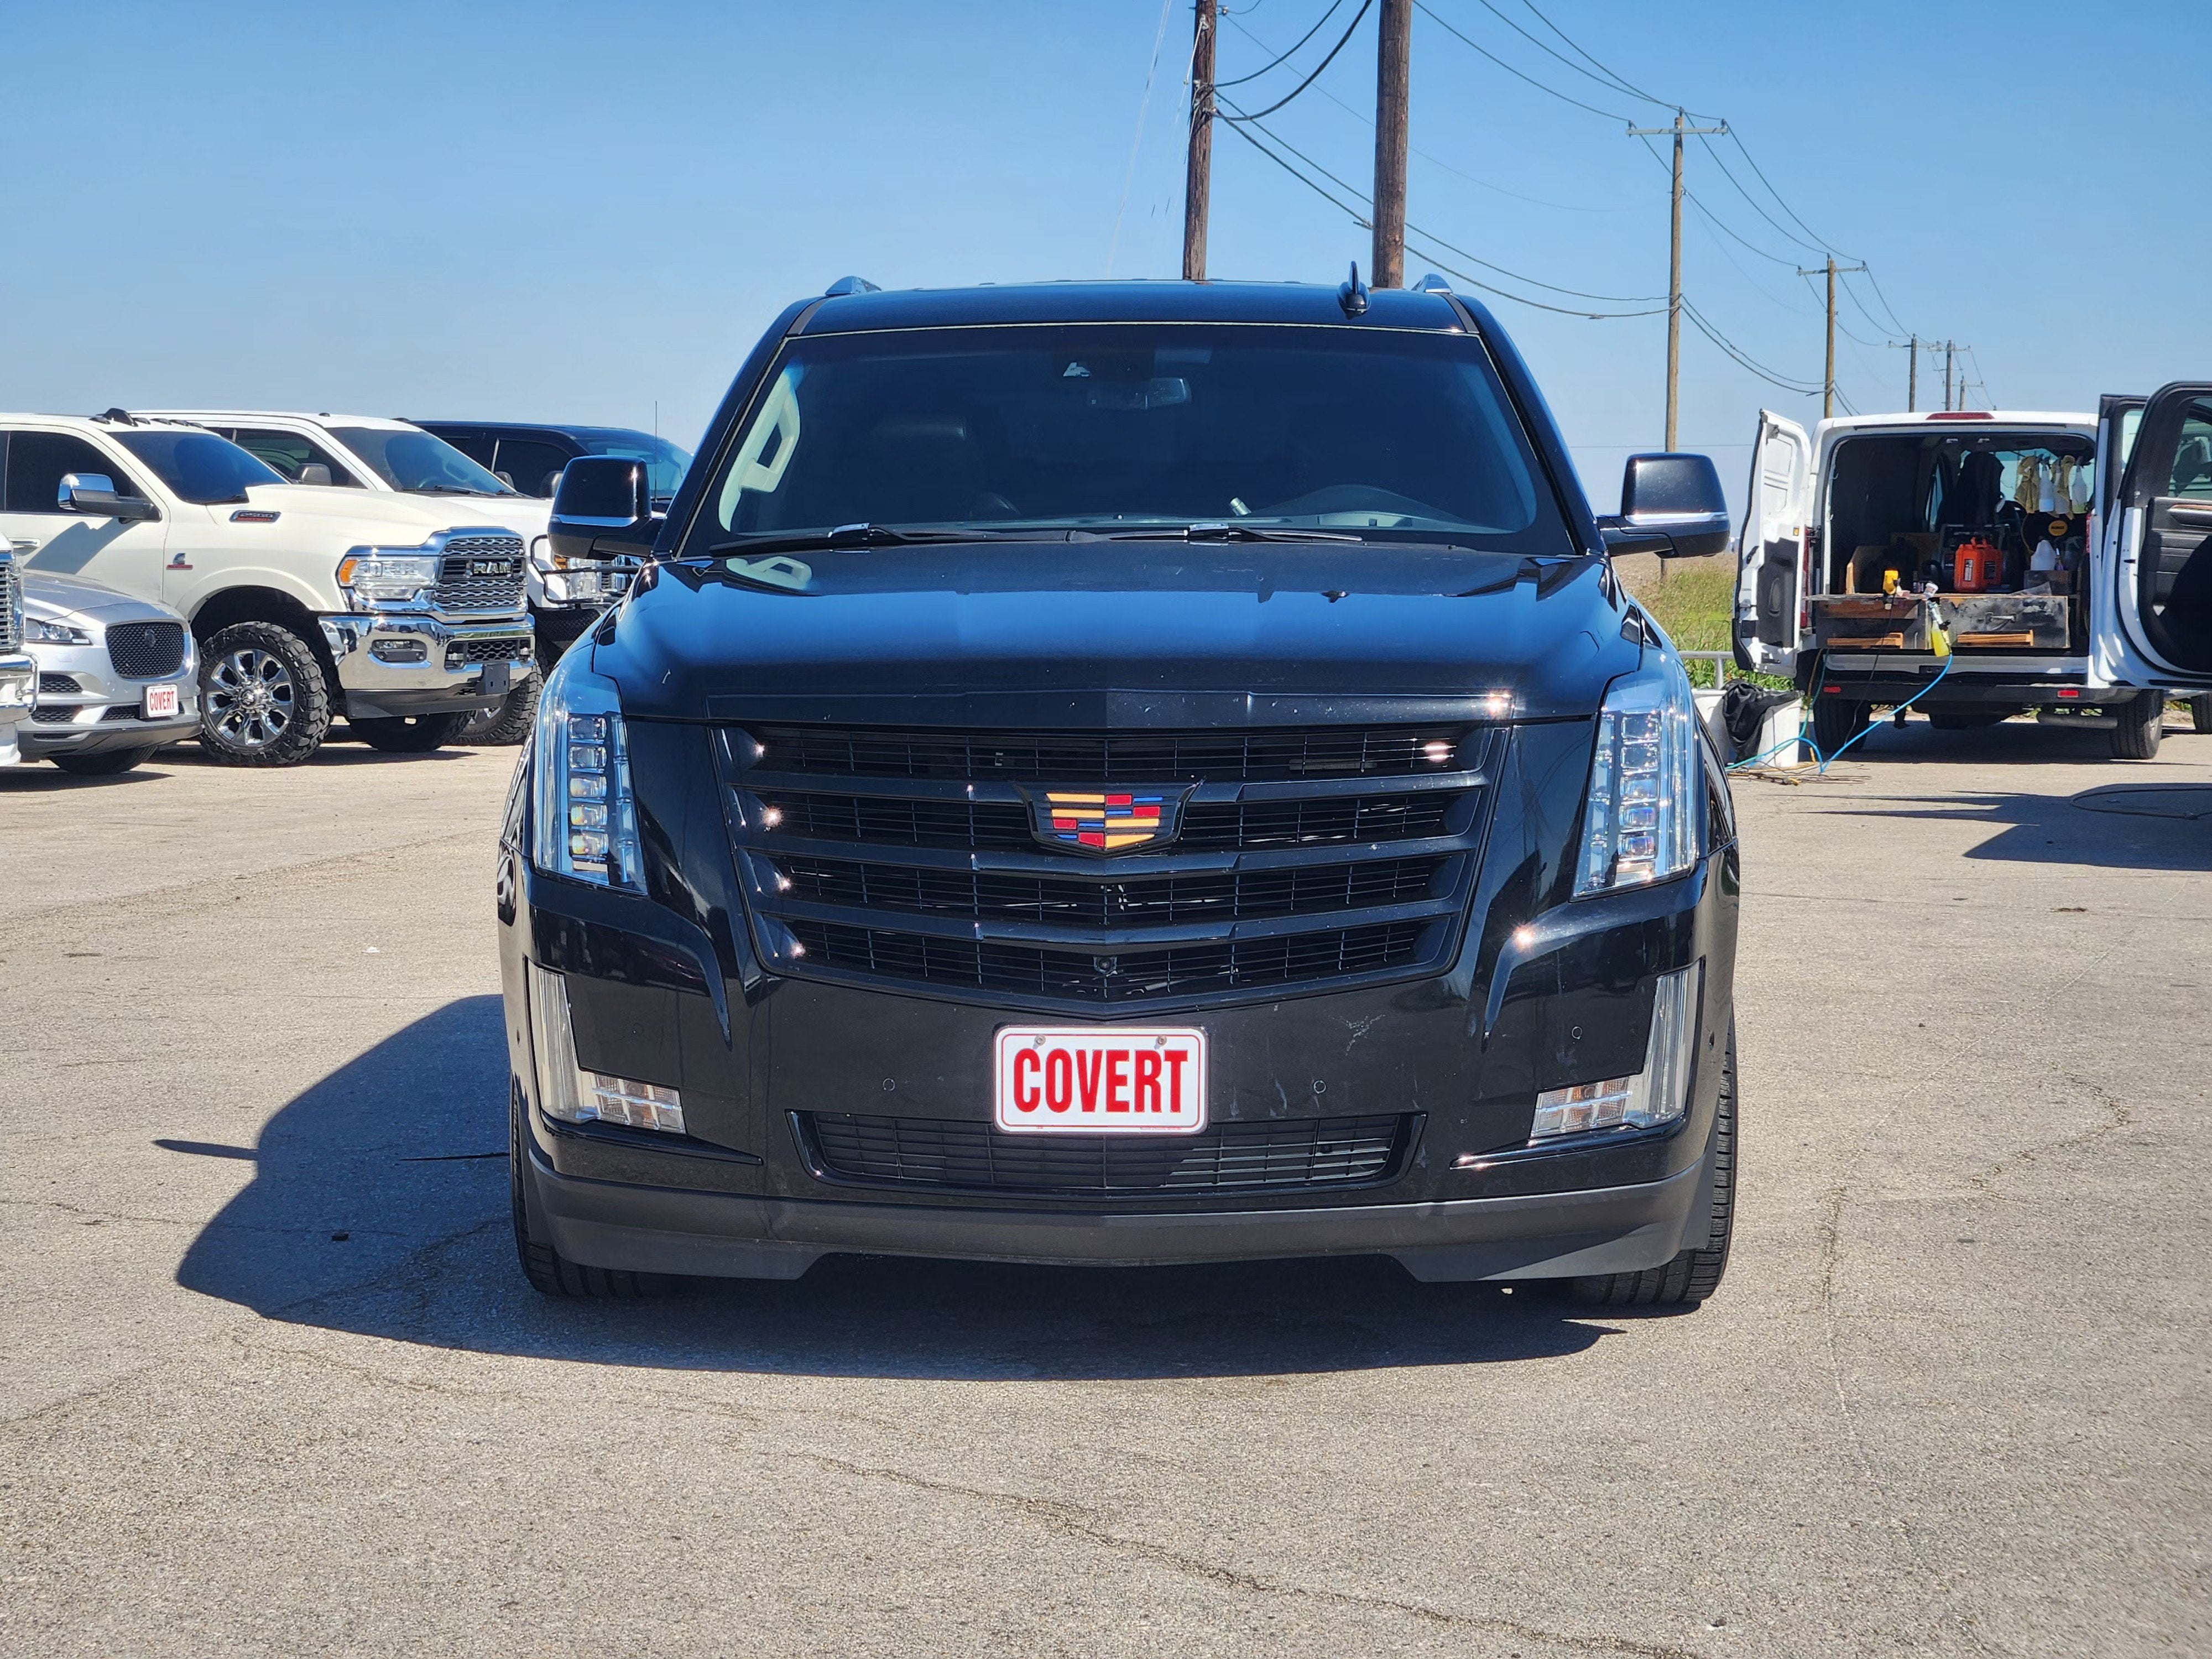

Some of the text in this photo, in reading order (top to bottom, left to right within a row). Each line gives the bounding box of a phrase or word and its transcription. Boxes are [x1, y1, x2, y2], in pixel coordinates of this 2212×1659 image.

[473, 561, 511, 573] RAM
[150, 691, 174, 711] COVERT
[1014, 1048, 1188, 1113] COVERT
